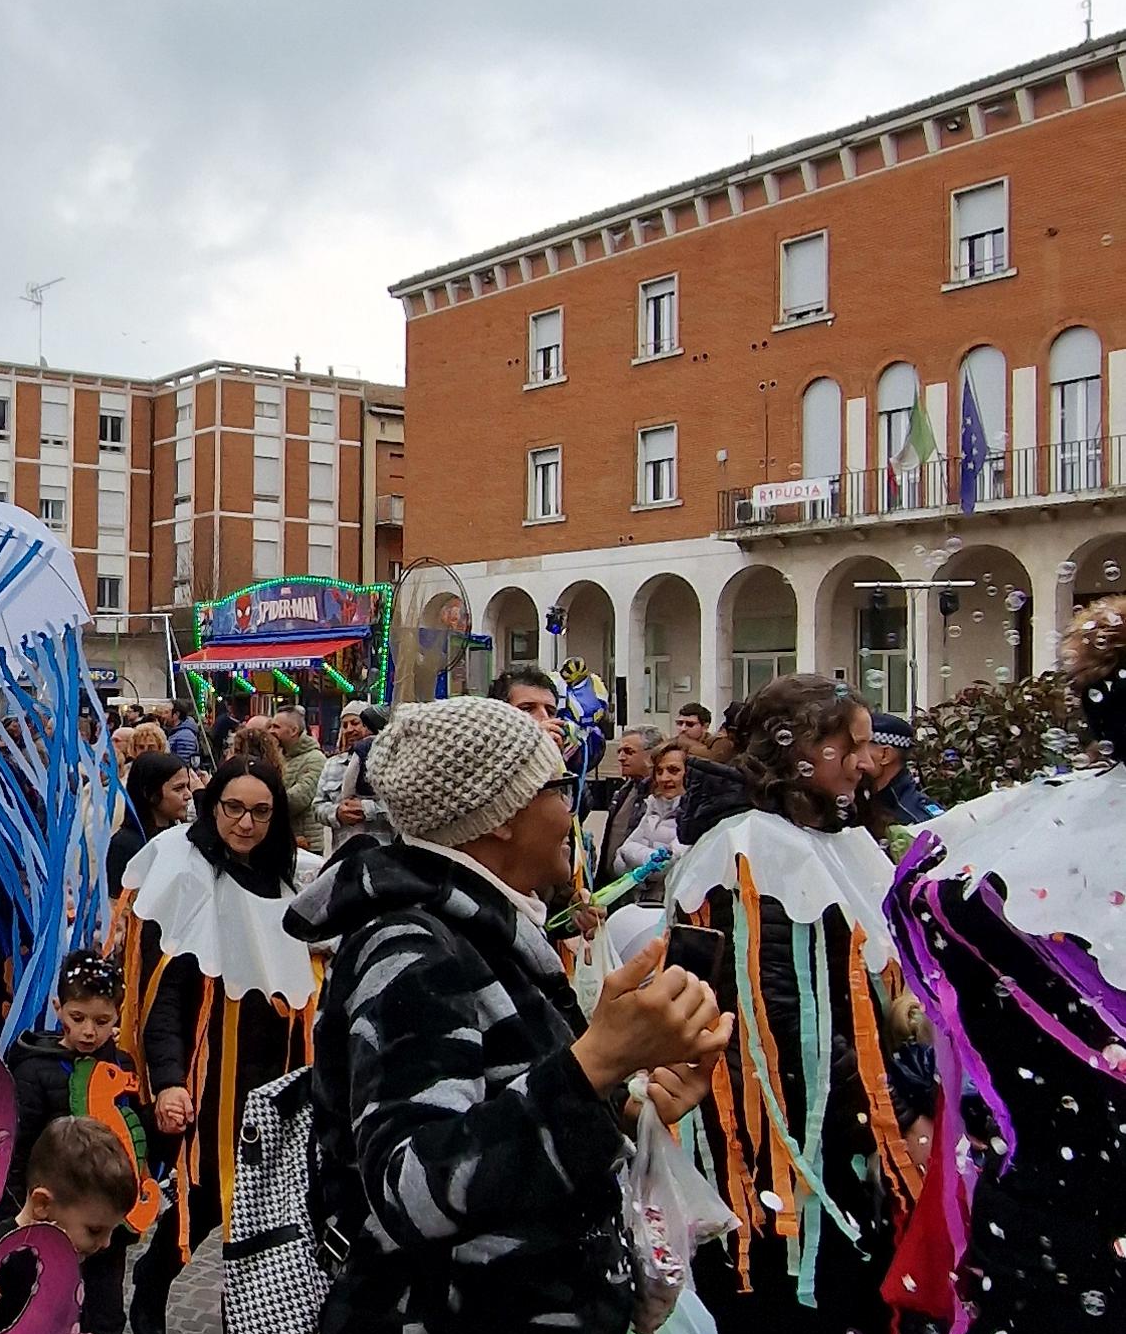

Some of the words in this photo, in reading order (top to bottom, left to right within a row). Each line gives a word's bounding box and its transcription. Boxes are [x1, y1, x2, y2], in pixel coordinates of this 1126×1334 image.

[256, 595, 319, 625] SPIDER-MAN
[179, 662, 234, 671] PERCORSO
[236, 658, 311, 669] FANTASTICO
